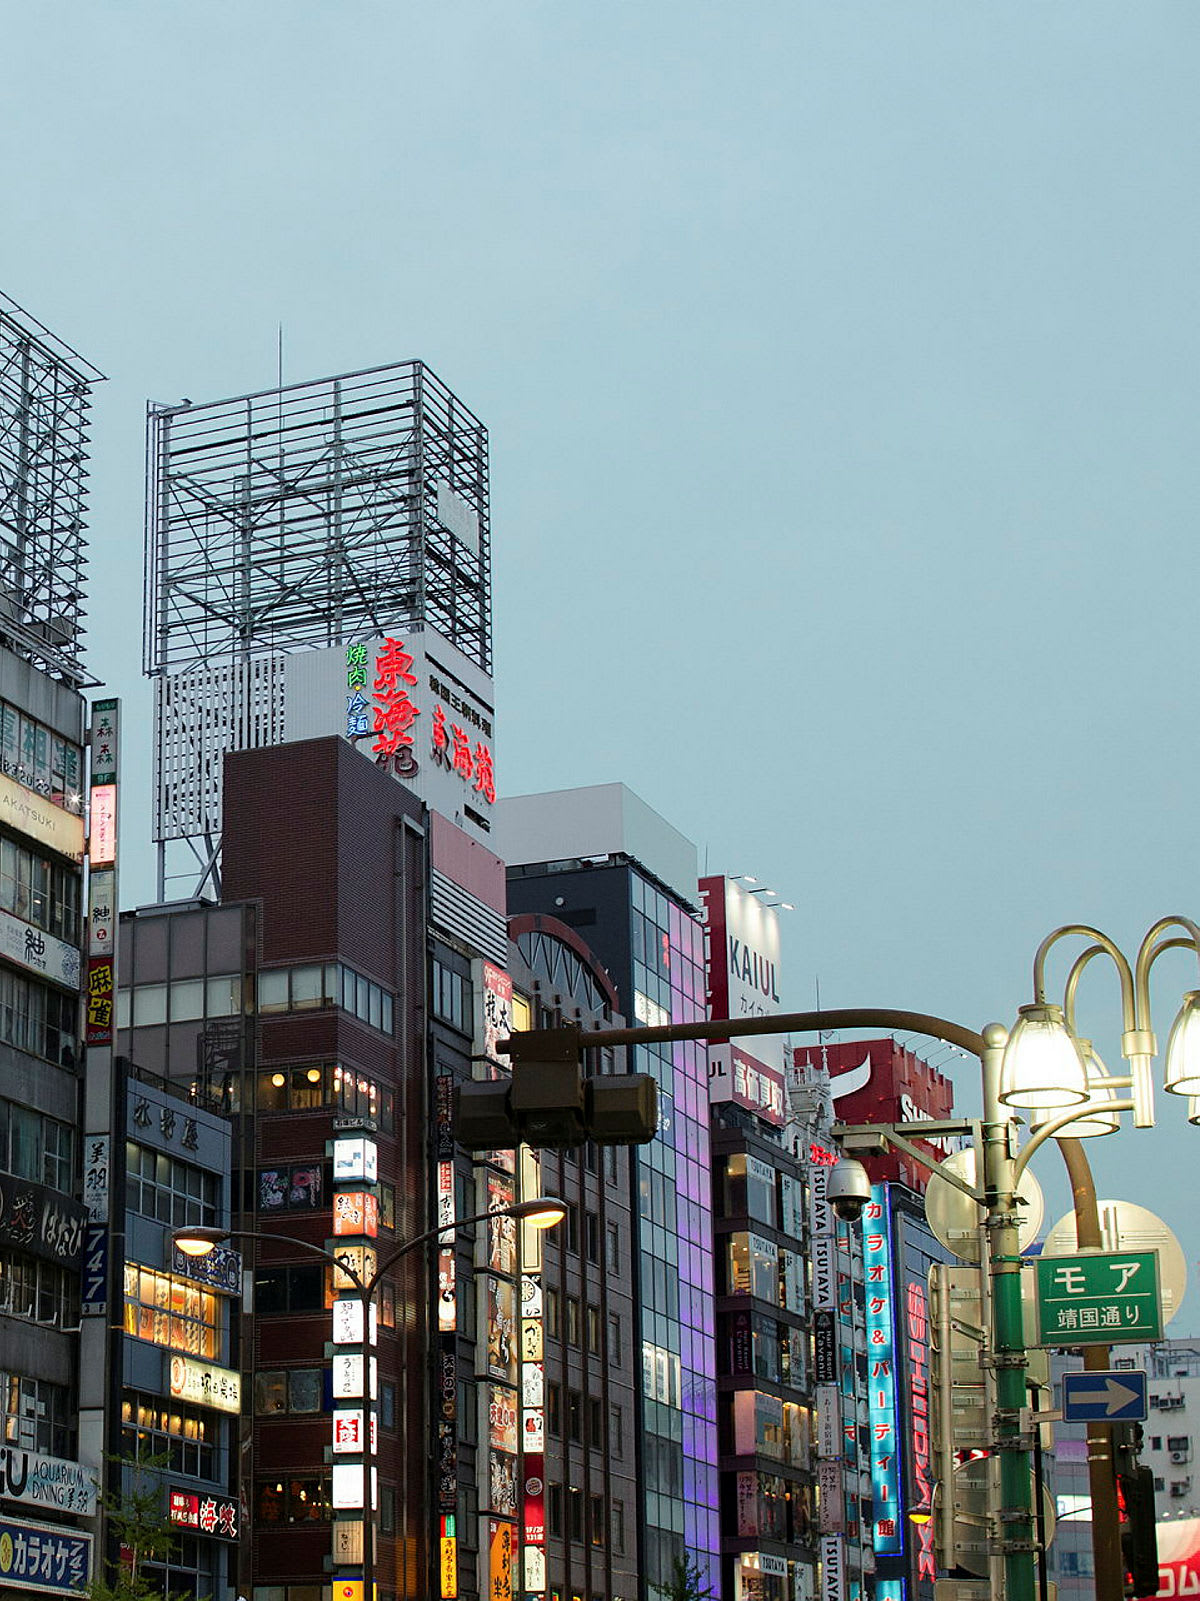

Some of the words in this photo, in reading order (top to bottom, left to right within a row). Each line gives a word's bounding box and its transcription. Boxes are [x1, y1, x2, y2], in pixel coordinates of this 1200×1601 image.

[3, 795, 56, 831] AKATSUKI
[730, 935, 780, 1003] KAIUL
[89, 965, 112, 1028] 麻雀
[86, 1141, 107, 1190] 美羽
[814, 1169, 826, 1230] TSUTAYA
[86, 1230, 105, 1300] 747
[817, 1242, 829, 1304] TSUTAYA
[1055, 1263, 1141, 1294] モア
[1057, 1305, 1141, 1330] 靖国通り
[866, 1202, 895, 1537] カラオケ&パーティー館
[32, 1481, 64, 1507] DINING
[33, 1462, 84, 1487] AQUARIUM
[13, 1533, 70, 1580] カラオケ
[69, 1540, 84, 1586] 747
[762, 1556, 785, 1572] TSUTAYA
